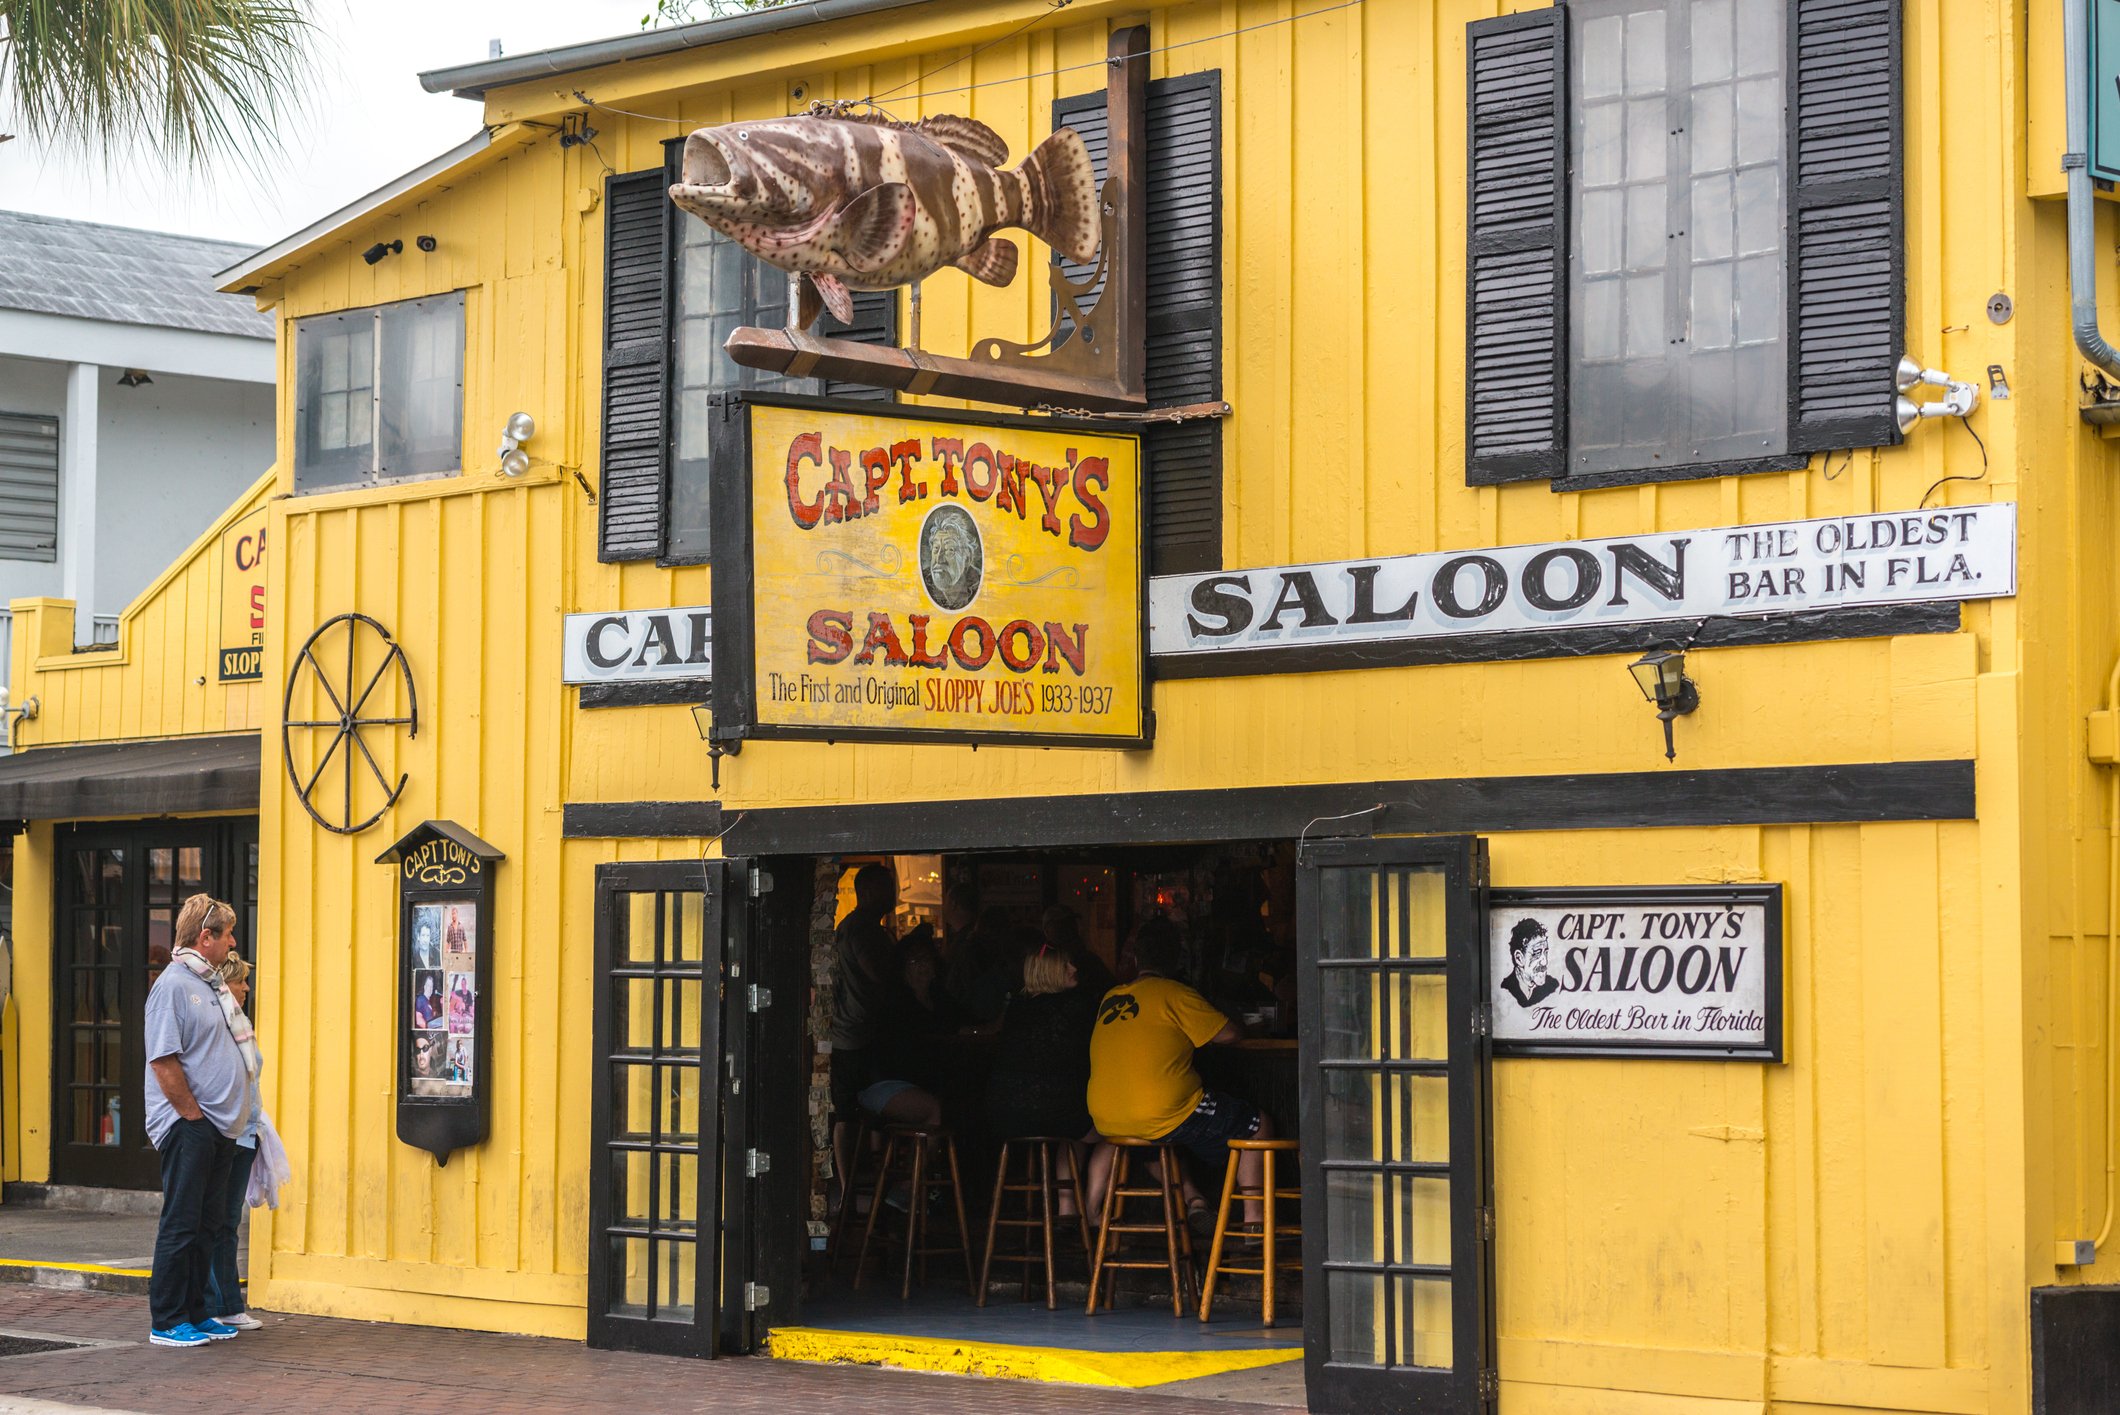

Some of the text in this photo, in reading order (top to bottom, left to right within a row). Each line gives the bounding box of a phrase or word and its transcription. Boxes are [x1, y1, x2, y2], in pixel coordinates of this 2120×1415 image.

[784, 432, 1110, 551] CAPT. TONY'S
[1725, 512, 1977, 560] THE OLDEST
[1186, 538, 1692, 638] SALOON
[1728, 553, 1982, 600] BAR IN FLA.
[806, 609, 1089, 676] SALOON
[769, 672, 1113, 715] The First and Original SLOPPY JOE'S 1933-1937
[404, 840, 437, 879] CAPT
[1557, 909, 1746, 940] CAPT. TONY'S
[1559, 945, 1748, 994] SALOON
[1529, 1005, 1764, 1031] The Oldest Bar in Florida
